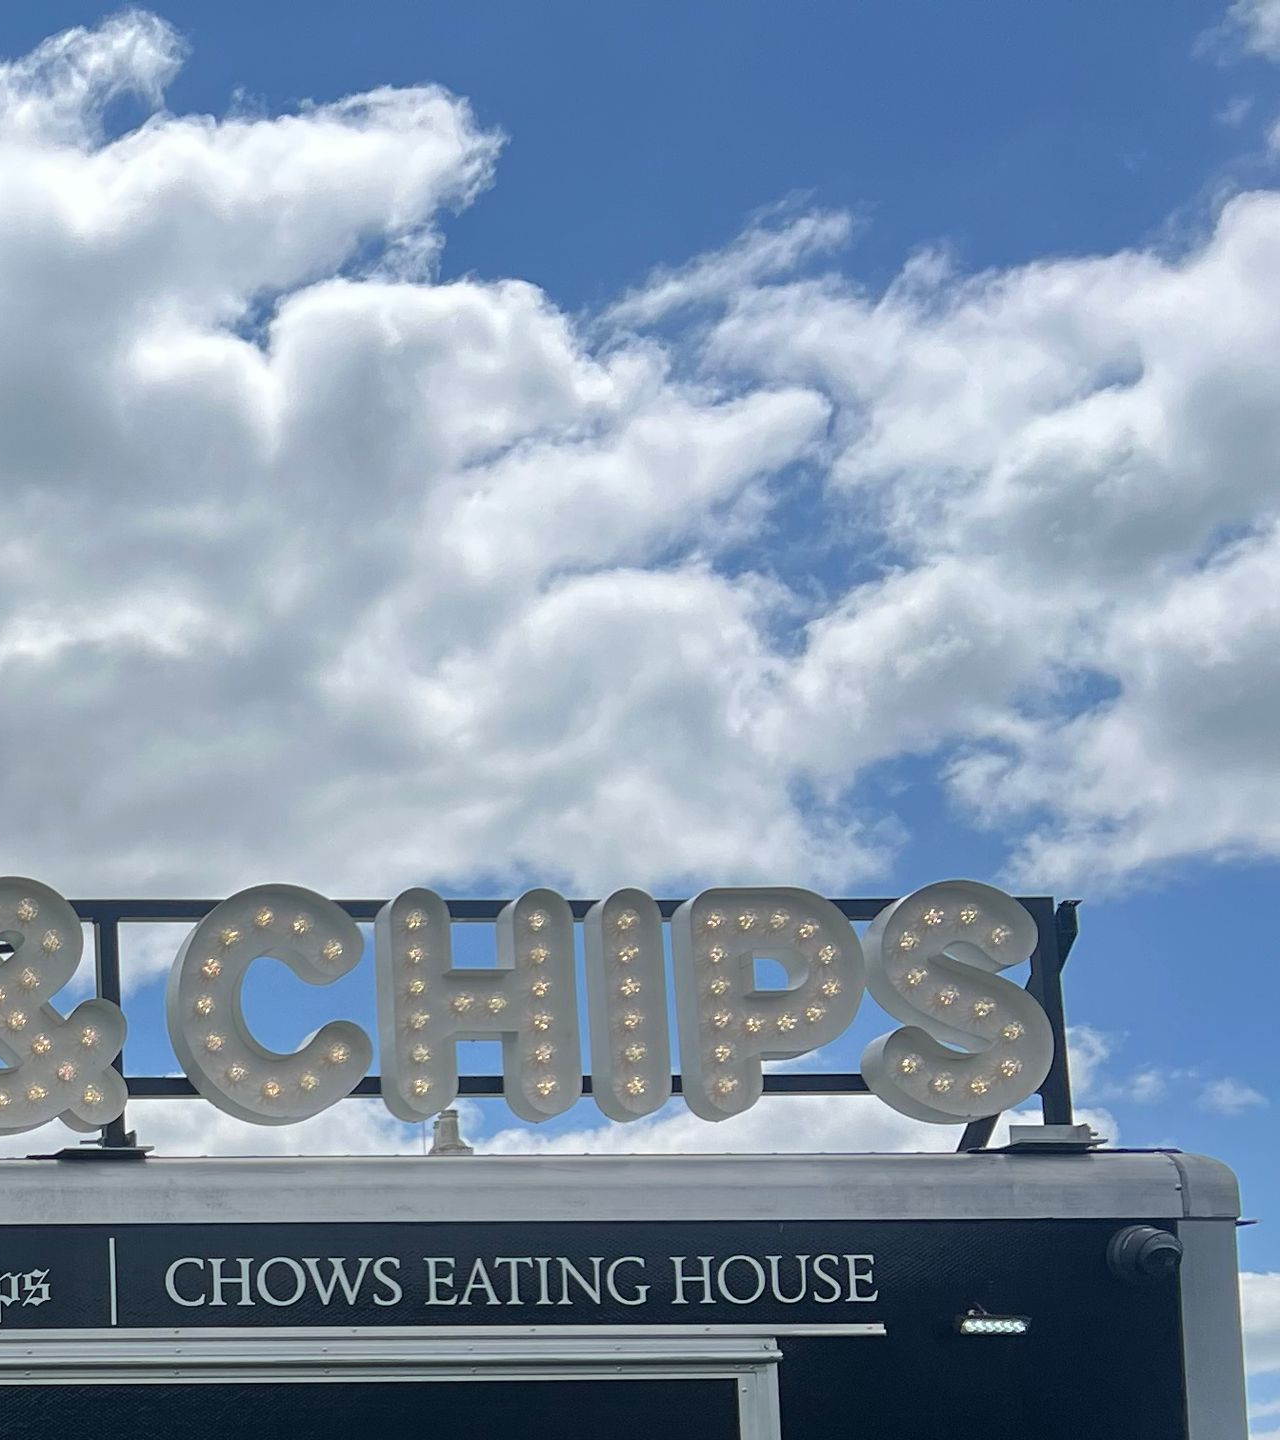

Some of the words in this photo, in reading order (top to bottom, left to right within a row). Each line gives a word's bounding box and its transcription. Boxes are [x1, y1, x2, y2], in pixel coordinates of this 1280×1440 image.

[166, 879, 1054, 1127] CHIPS
[165, 1257, 403, 1306] CHOWS
[423, 1256, 651, 1306] EATING
[669, 1253, 879, 1304] HOUSE
